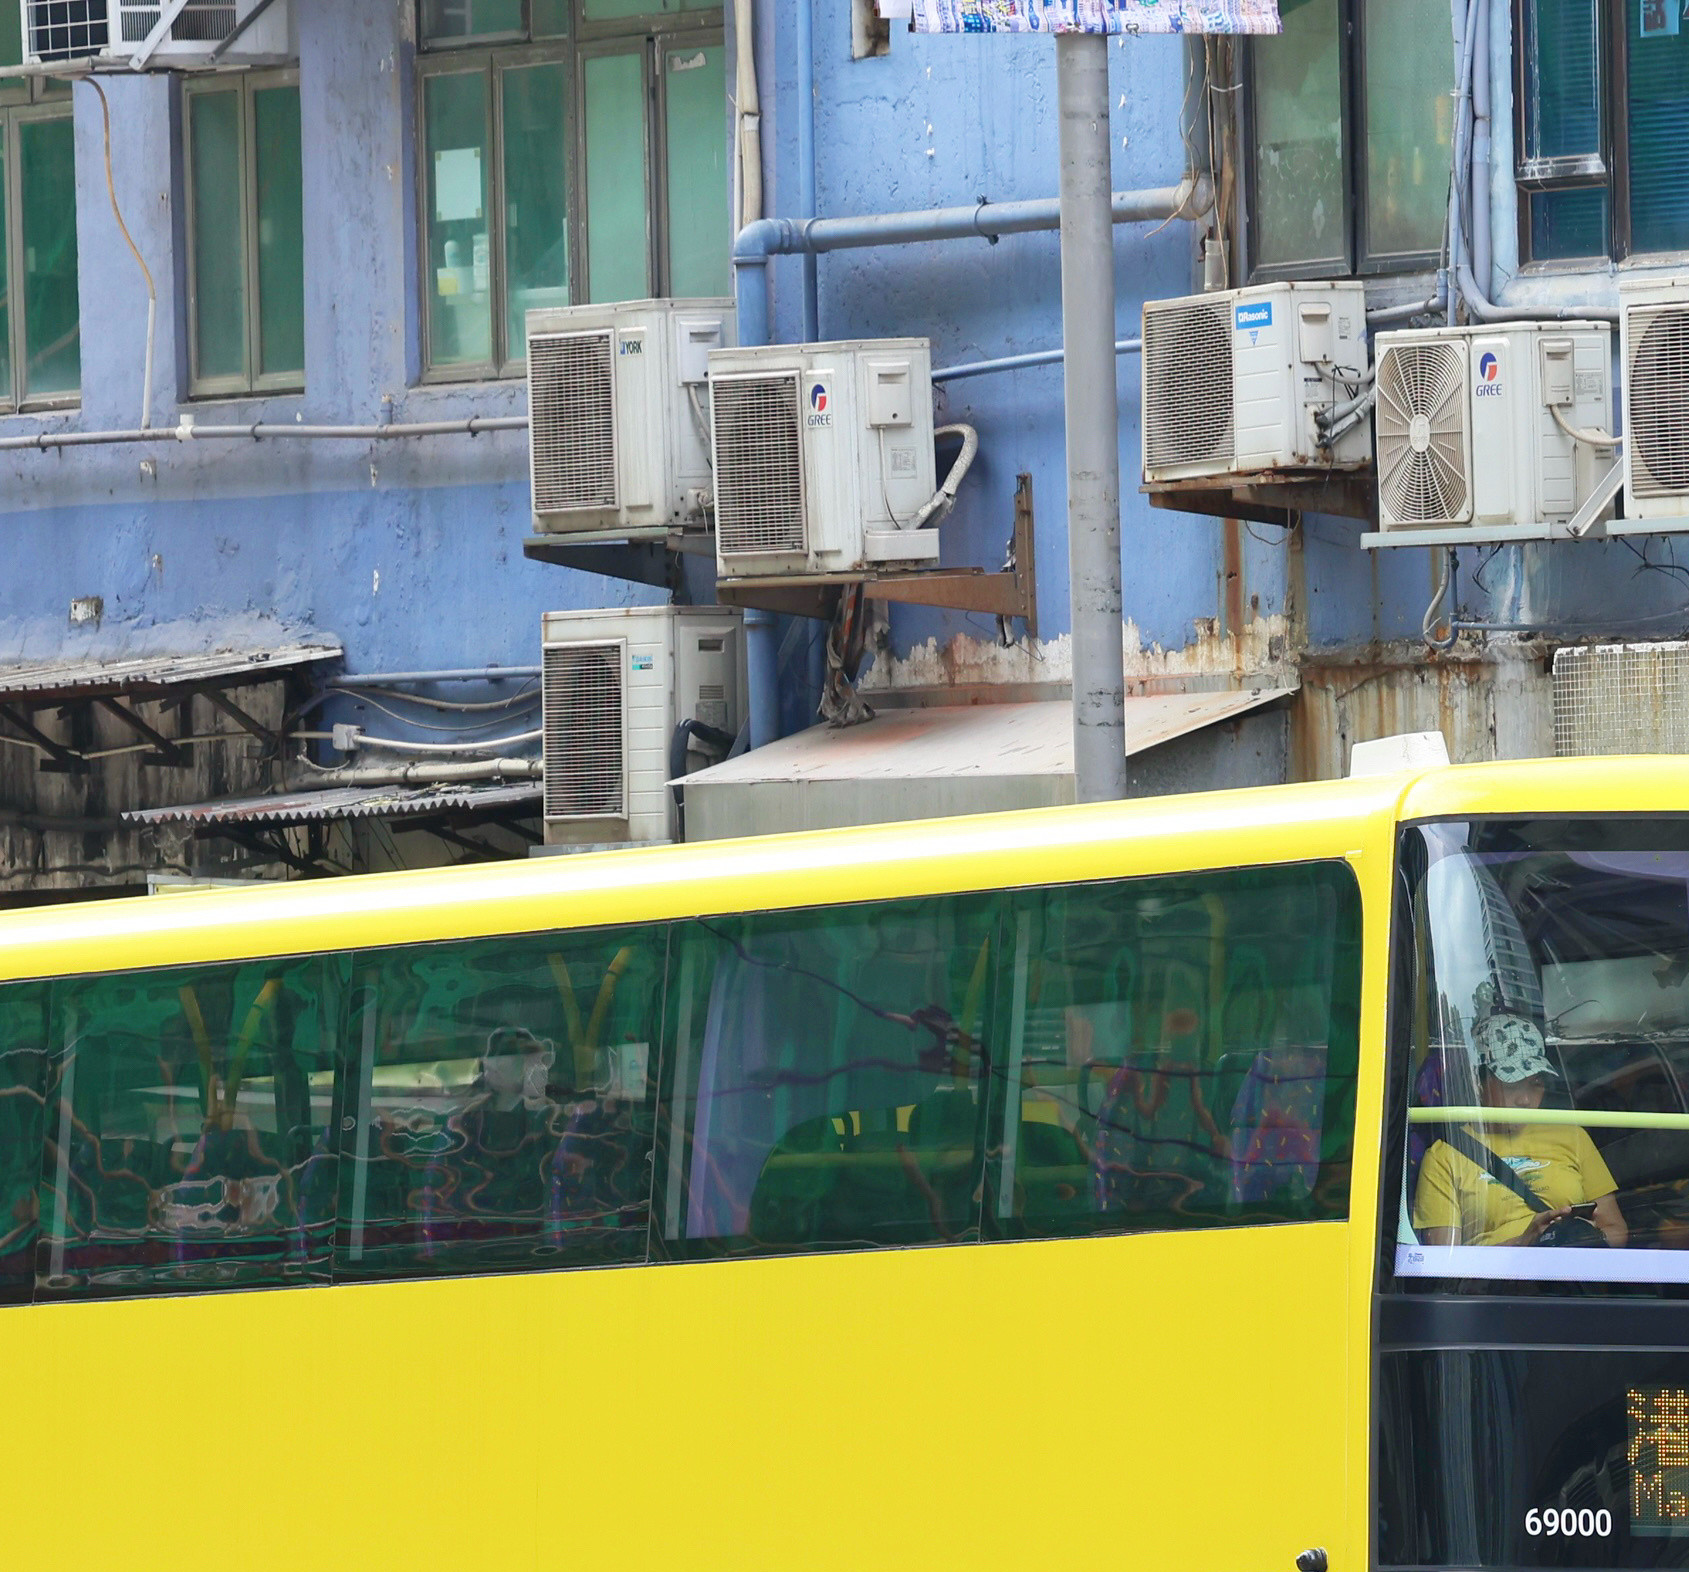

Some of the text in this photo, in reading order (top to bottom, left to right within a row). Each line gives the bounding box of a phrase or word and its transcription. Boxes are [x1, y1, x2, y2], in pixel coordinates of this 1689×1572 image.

[625, 341, 642, 354] YORK
[1475, 384, 1502, 397] GREE
[808, 414, 831, 427] GREE
[1524, 1508, 1613, 1538] 69000
